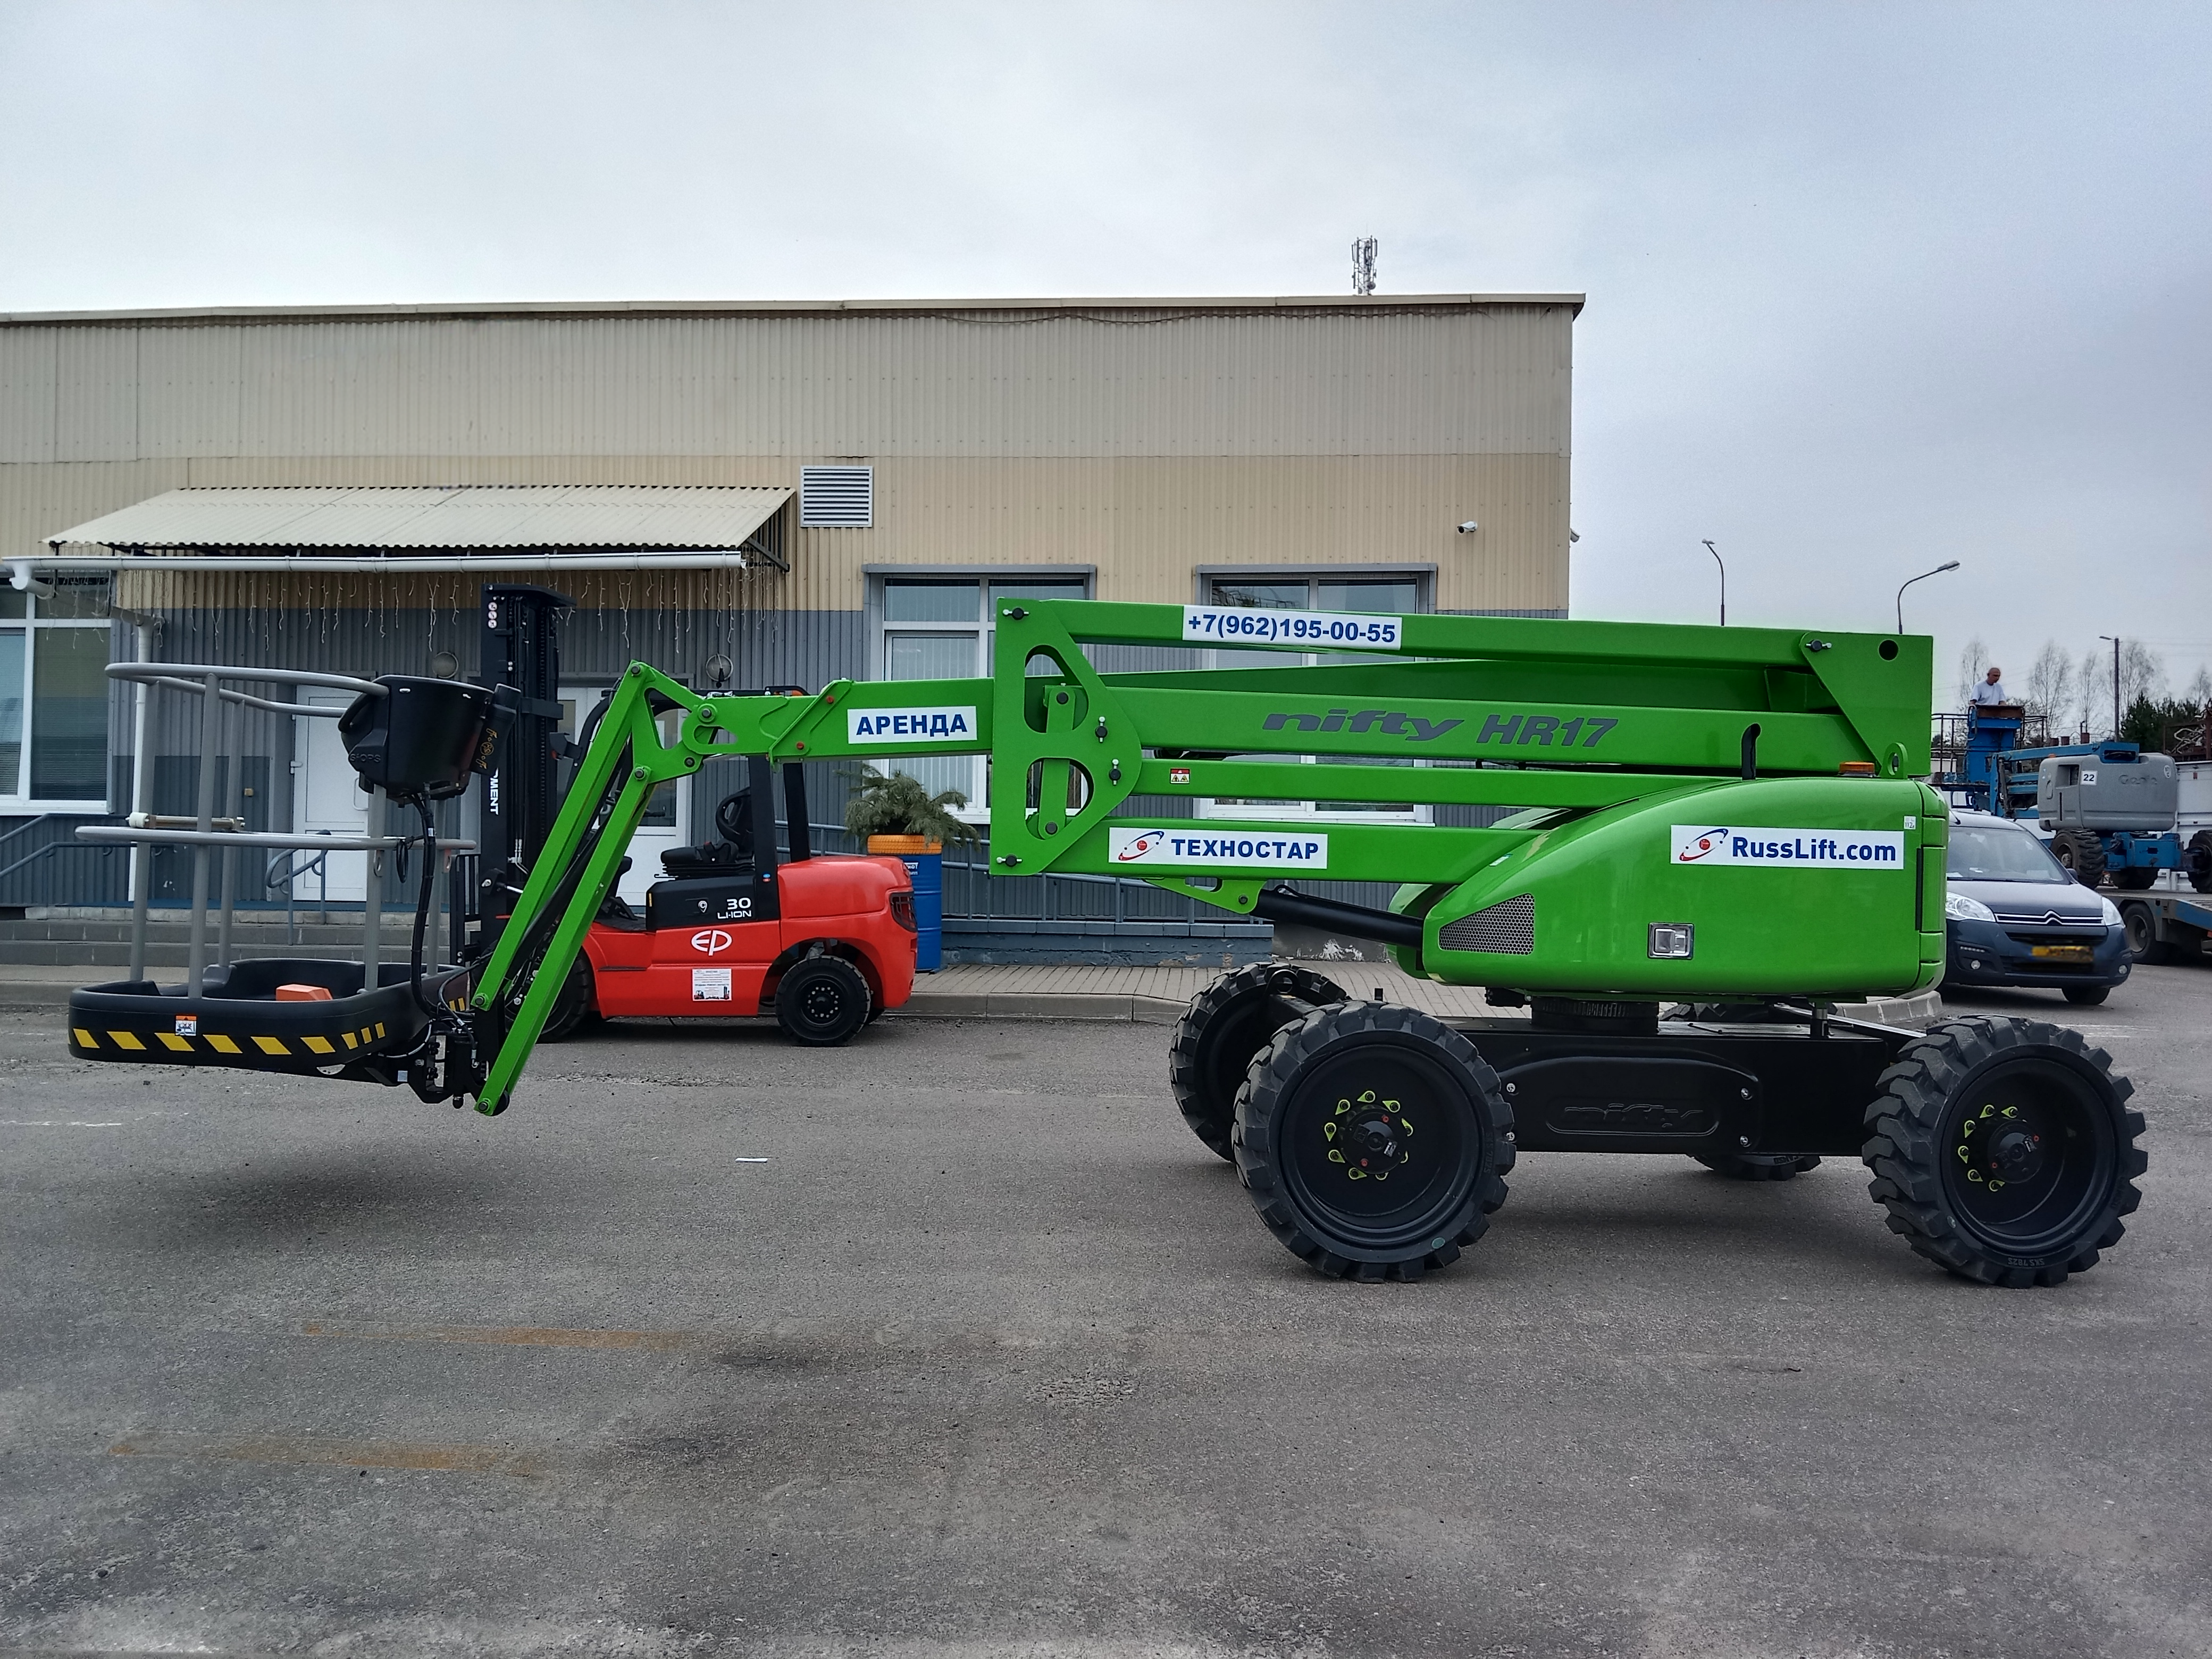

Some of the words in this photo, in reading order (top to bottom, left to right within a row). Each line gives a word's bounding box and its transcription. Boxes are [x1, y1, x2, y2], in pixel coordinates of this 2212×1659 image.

[1188, 615, 1395, 642] +7(962)195-00-55
[856, 714, 967, 737] АРЕНДА
[1262, 709, 1465, 741] nifty
[1476, 715, 1619, 747] HR17
[1171, 839, 1319, 859] ТЕХНОСТАР
[1732, 836, 1896, 861] RussLift.com
[726, 897, 751, 910] 30
[691, 930, 732, 956] EP
